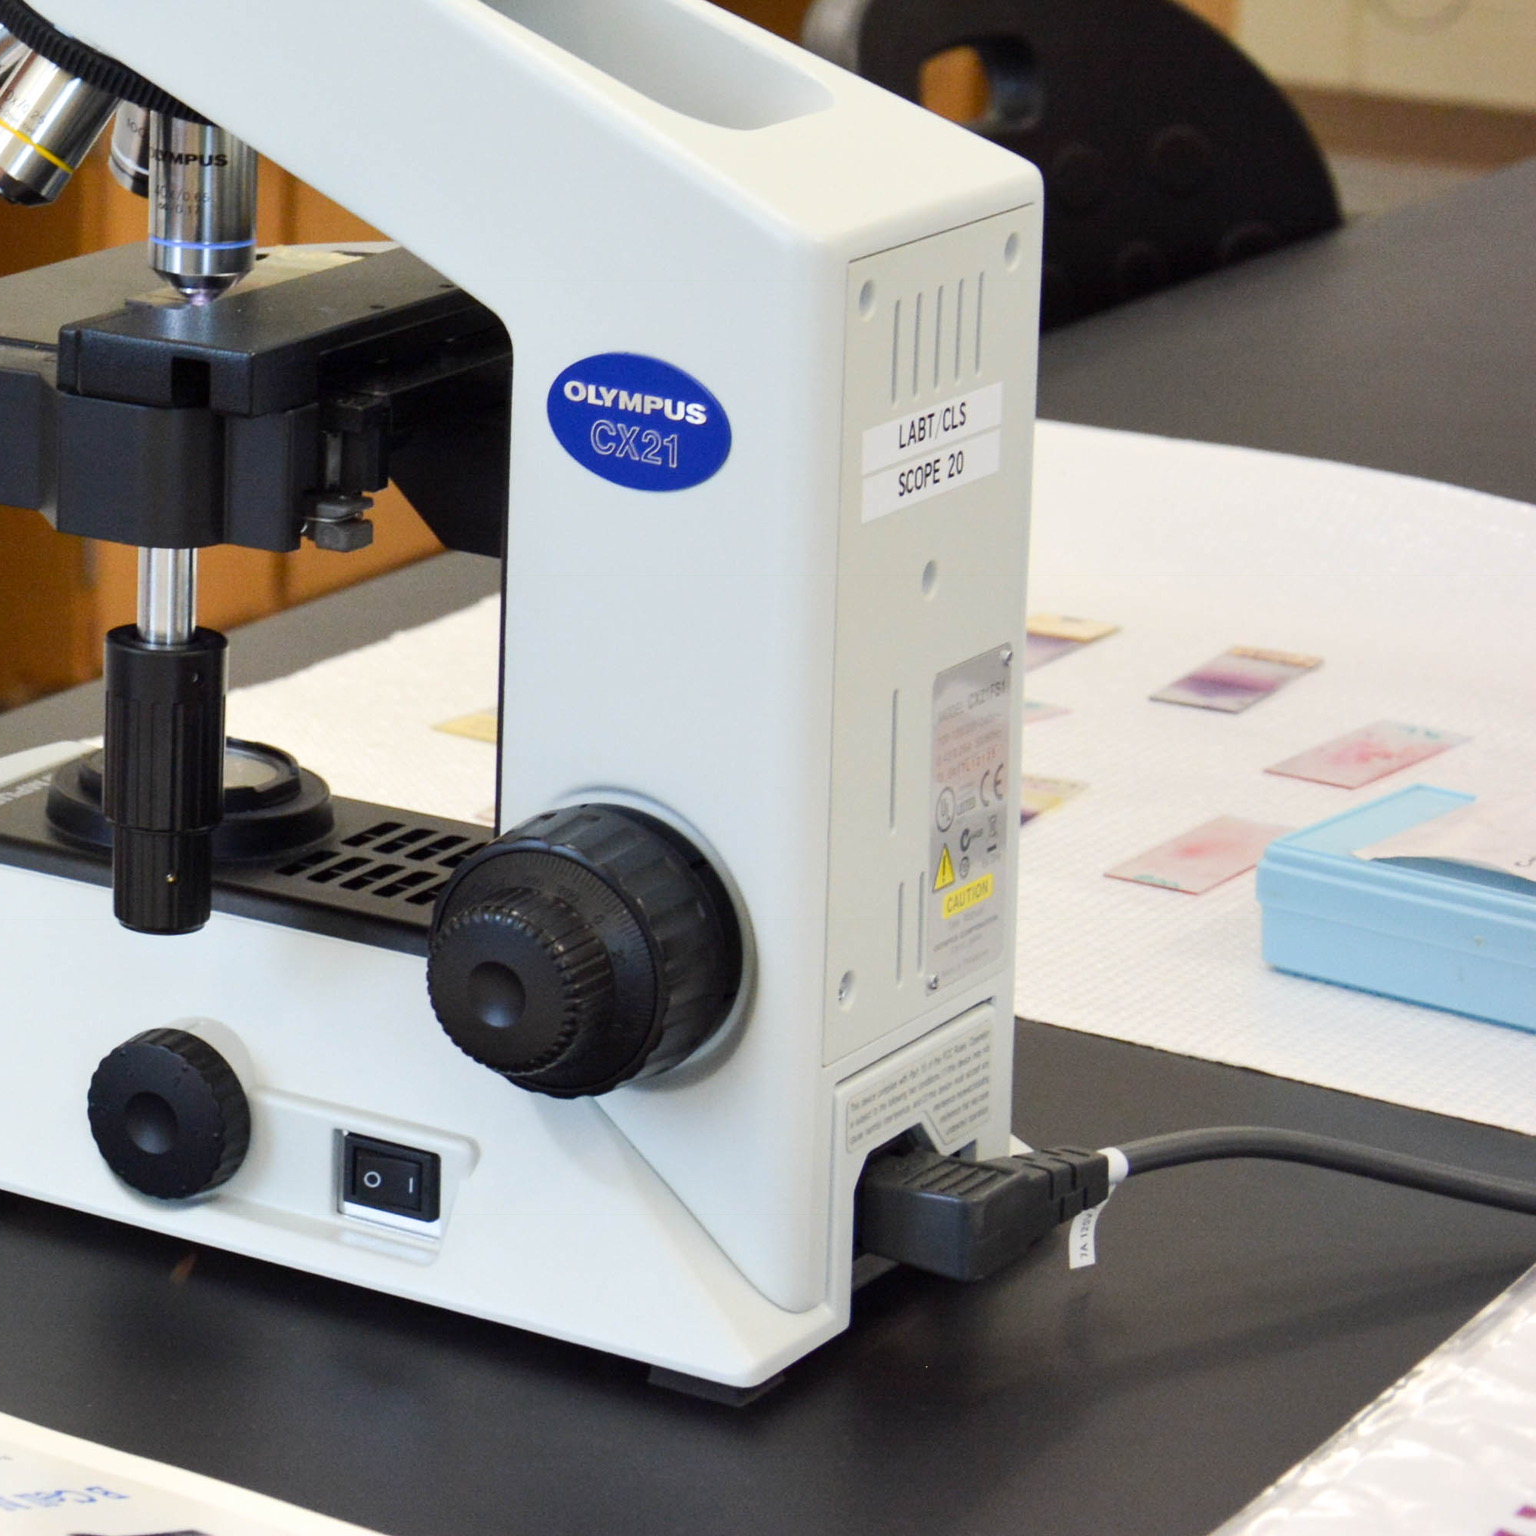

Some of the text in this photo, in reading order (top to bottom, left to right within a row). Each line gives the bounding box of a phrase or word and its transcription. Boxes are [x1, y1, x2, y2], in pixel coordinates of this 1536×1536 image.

[563, 380, 708, 425] OLYMPUS
[897, 400, 967, 450] LABT/CLS
[590, 419, 679, 468] CX21
[897, 450, 965, 497] SCOPE 20
[947, 879, 989, 913] CAUTION
